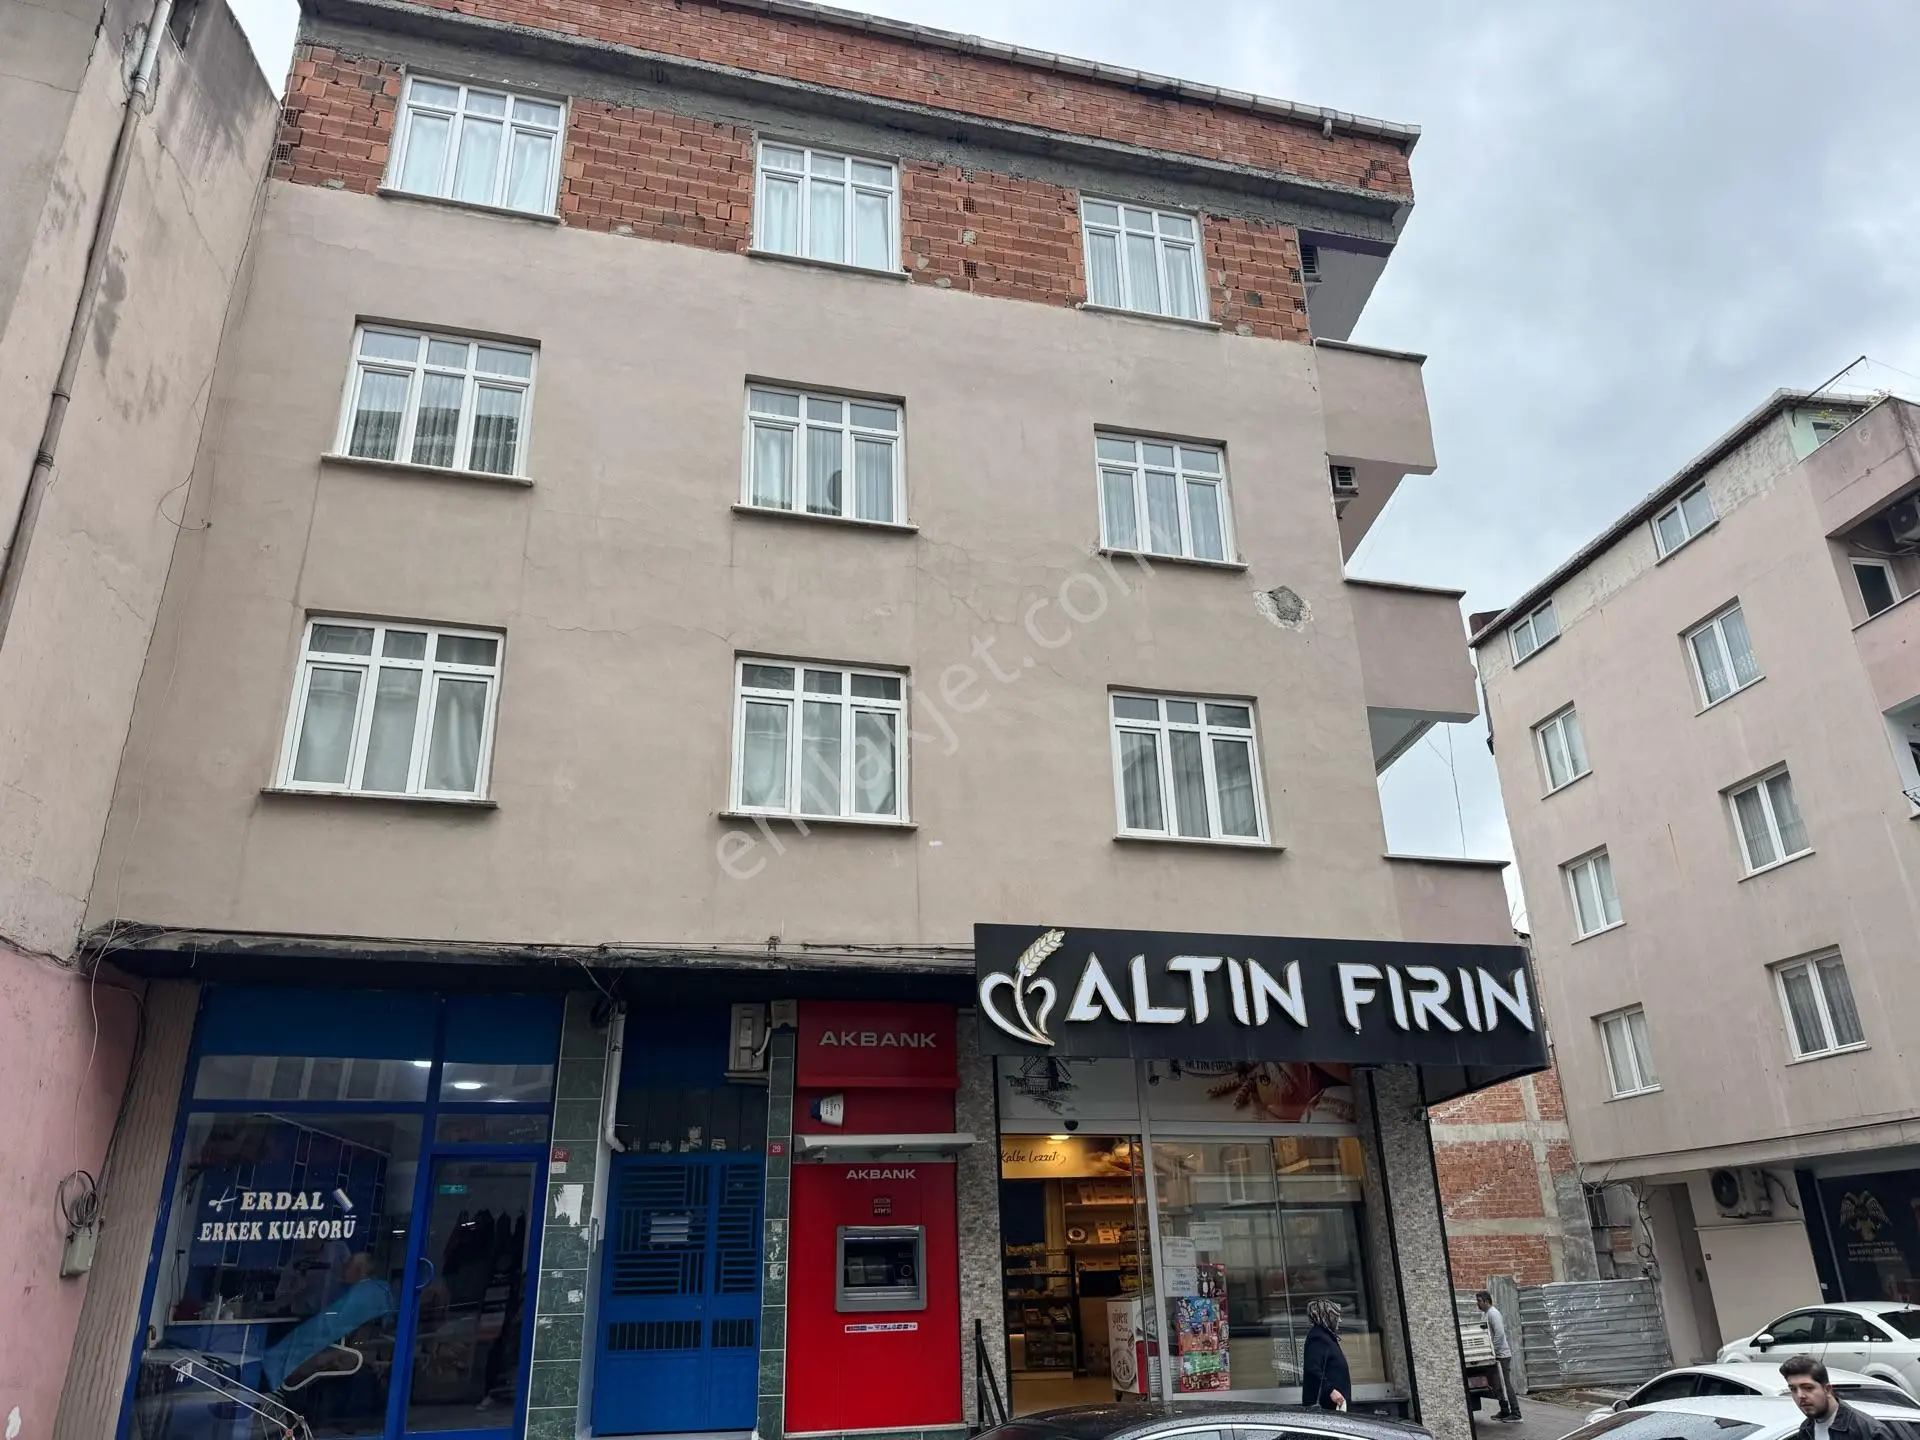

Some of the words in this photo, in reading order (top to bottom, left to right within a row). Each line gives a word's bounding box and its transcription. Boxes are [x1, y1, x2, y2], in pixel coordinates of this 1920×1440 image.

[1064, 952, 1309, 1028] ALTIN
[1337, 962, 1536, 1033] FIRIN
[819, 1031, 938, 1048] AKBANK
[1001, 1149, 1025, 1164] Kalbe
[846, 1169, 917, 1180] AKBANK
[240, 1191, 325, 1211] ERDAL
[200, 1221, 263, 1242] ERKEK
